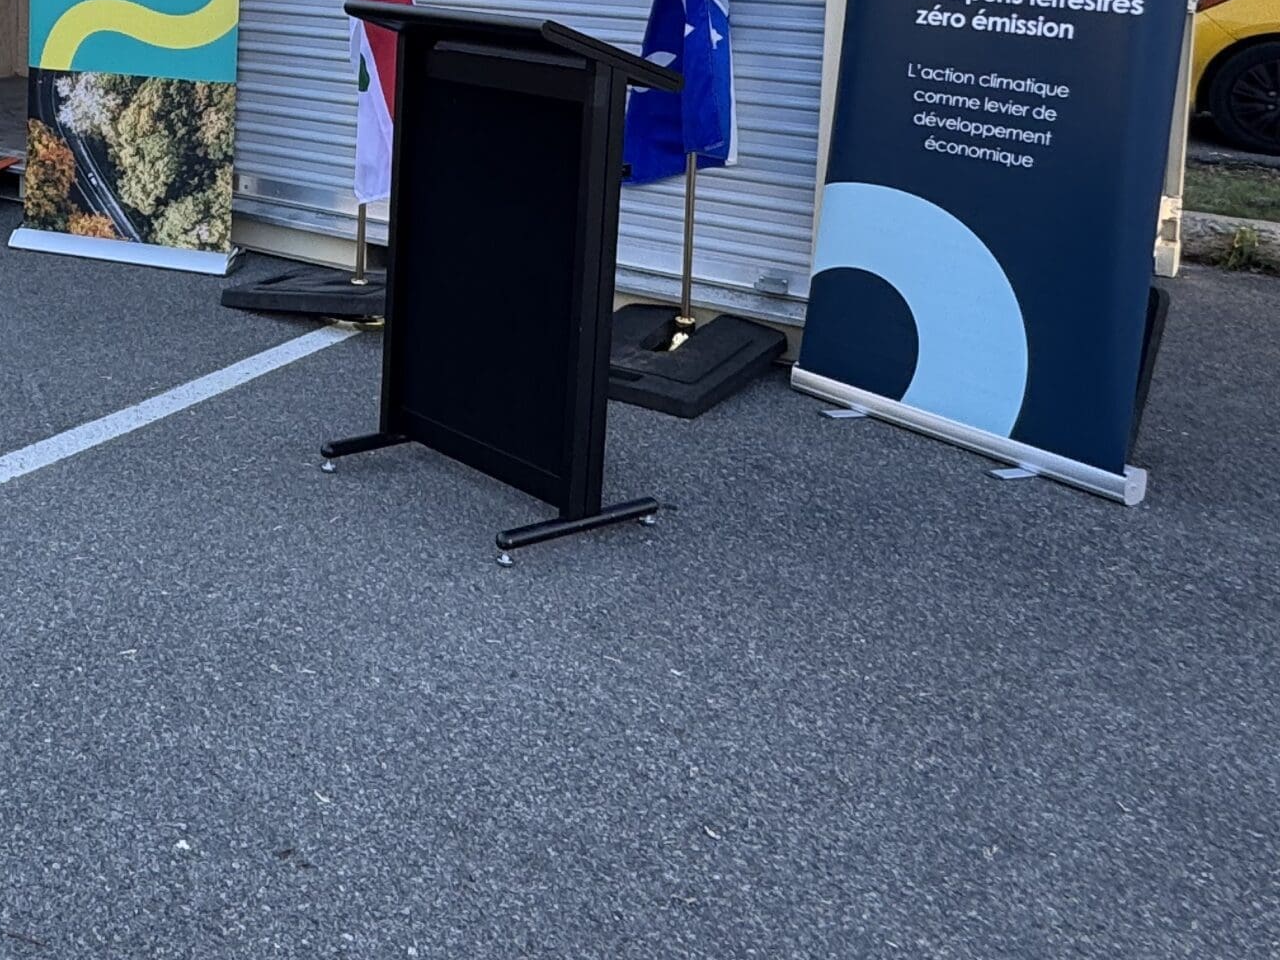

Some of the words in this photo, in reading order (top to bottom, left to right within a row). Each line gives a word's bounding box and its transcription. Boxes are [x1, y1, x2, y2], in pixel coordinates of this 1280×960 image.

[915, 5, 967, 29] zéro
[971, 8, 1075, 40] émission
[907, 62, 976, 87] L'action
[978, 72, 1070, 99] climatique
[913, 89, 981, 111] comme
[984, 95, 1029, 118] levier
[1032, 98, 1058, 122] de
[913, 110, 1052, 147] développement
[924, 134, 1035, 169] économique
